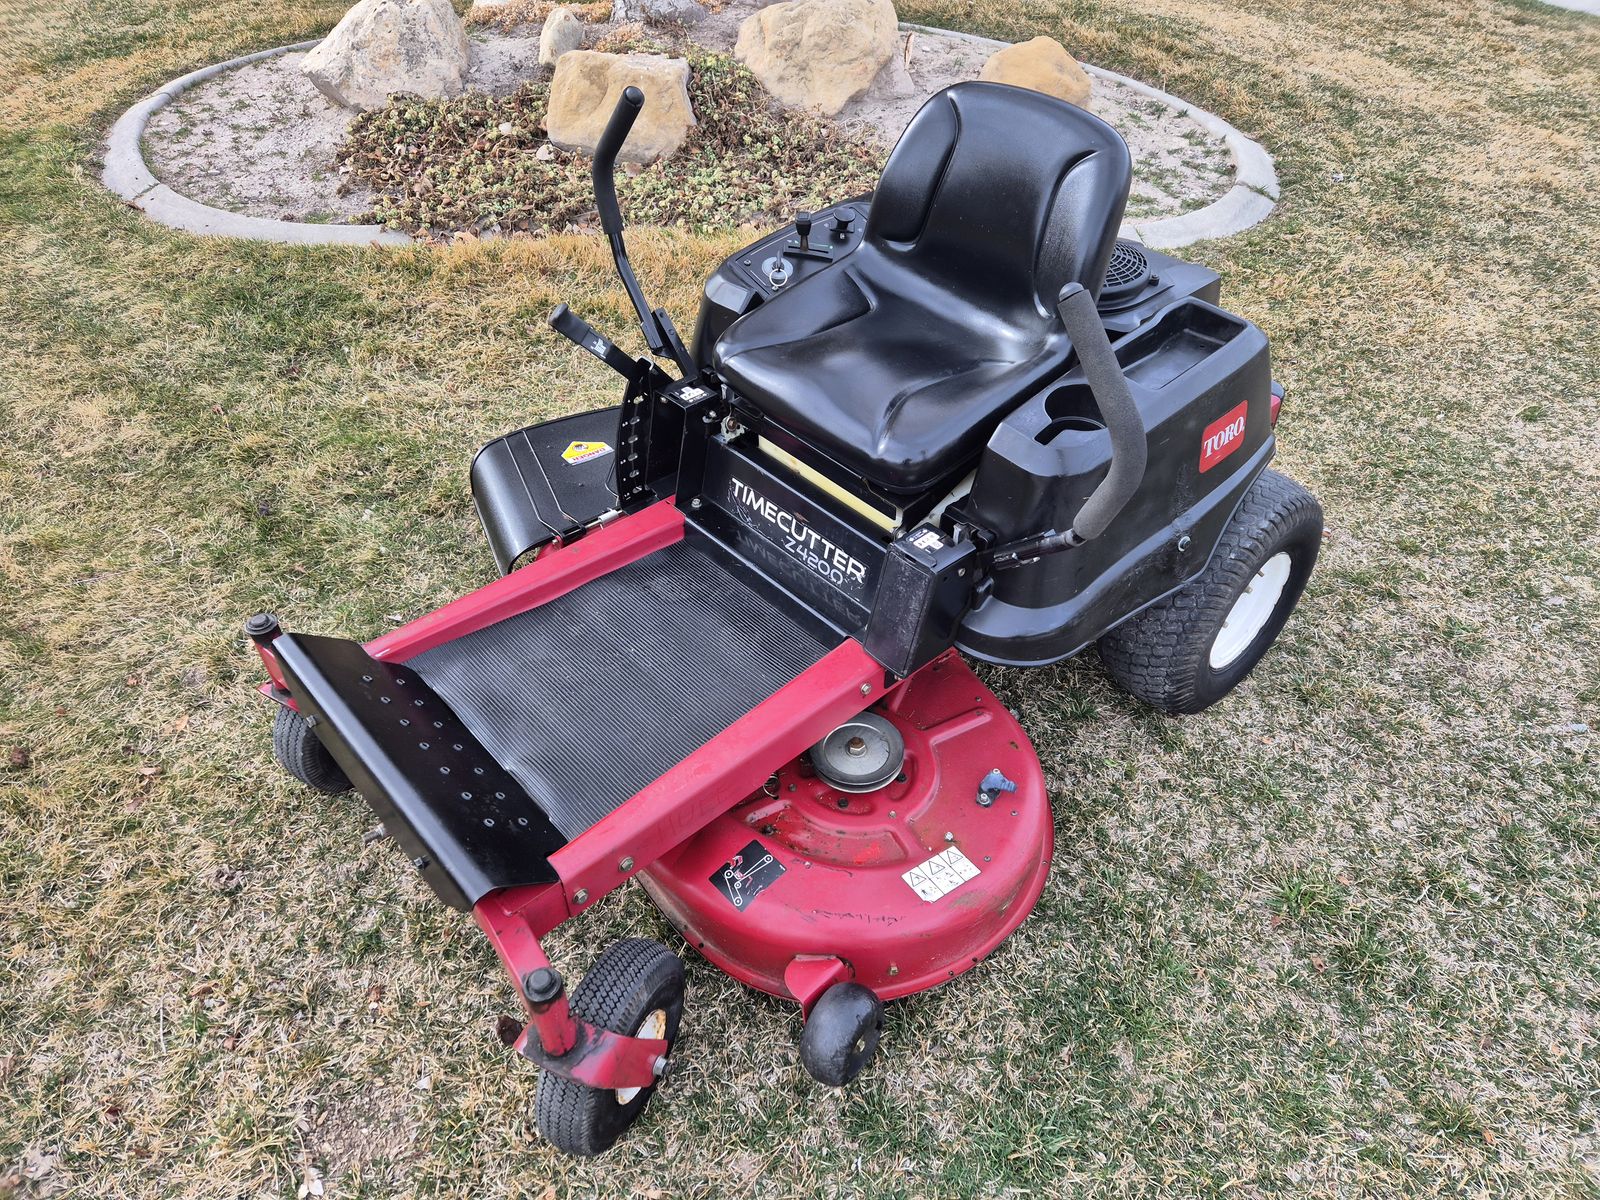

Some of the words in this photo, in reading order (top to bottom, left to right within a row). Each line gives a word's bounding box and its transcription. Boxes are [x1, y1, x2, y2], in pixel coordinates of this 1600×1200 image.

[1204, 416, 1245, 458] TORO
[732, 478, 866, 583] TIMECUTTER
[784, 535, 844, 585] Z4200
